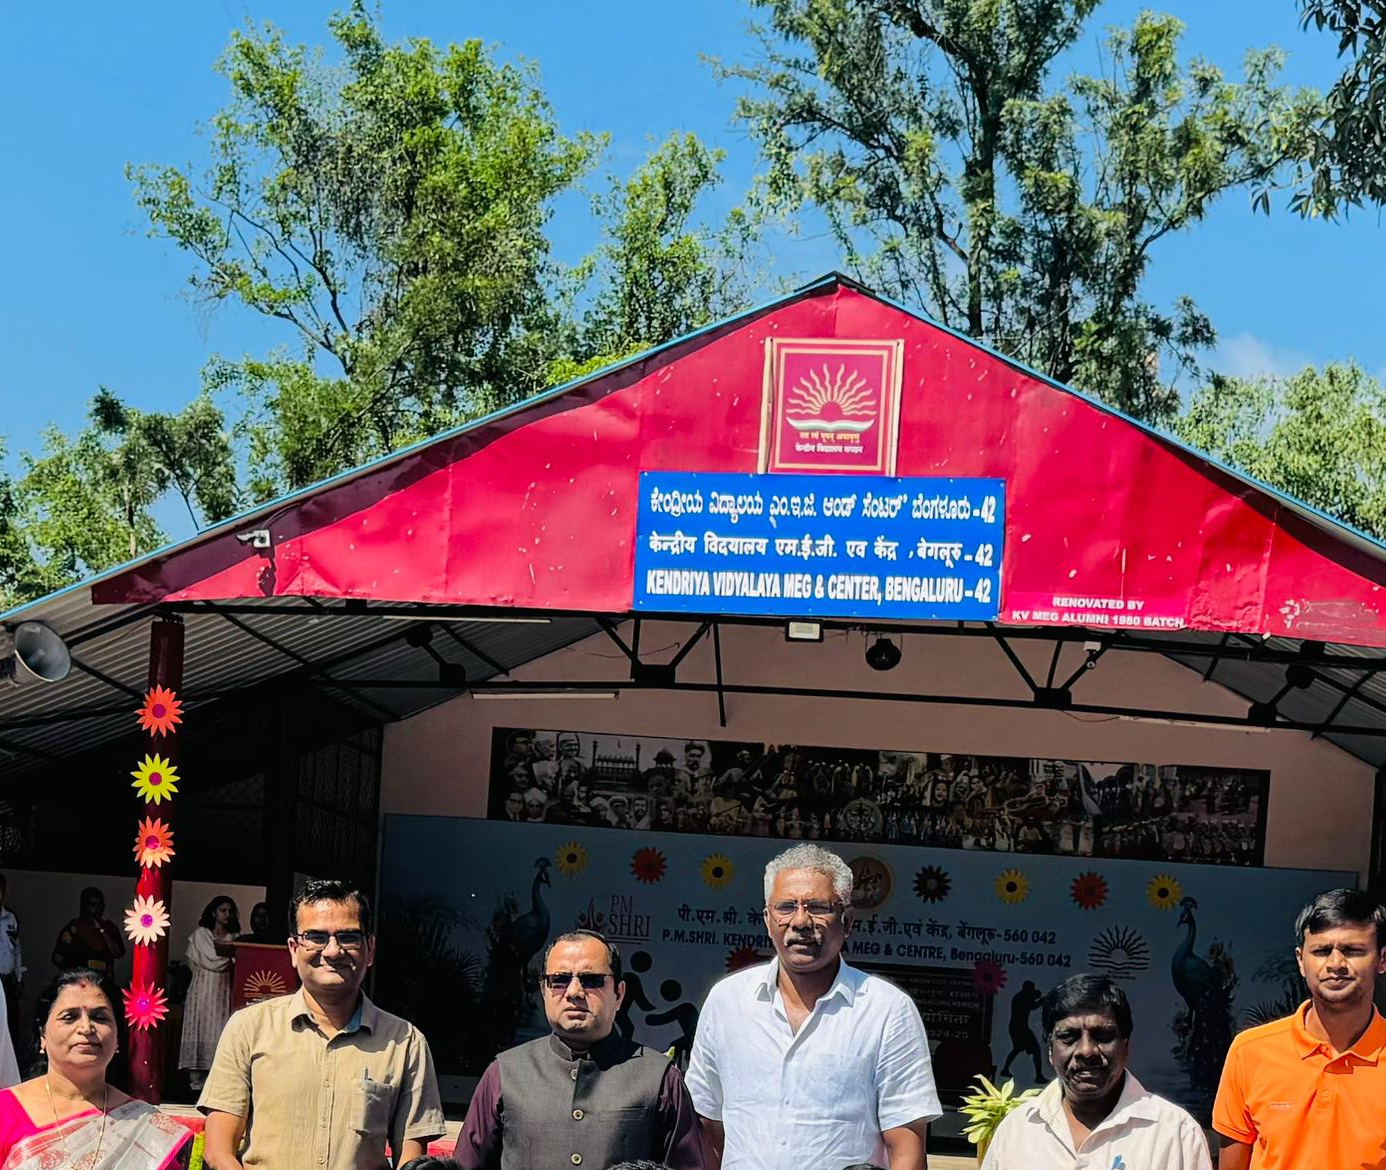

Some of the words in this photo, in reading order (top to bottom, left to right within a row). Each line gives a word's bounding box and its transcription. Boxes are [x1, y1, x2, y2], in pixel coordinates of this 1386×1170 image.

[646, 569, 711, 596] KENDRIYA
[712, 571, 781, 598] VIDYALAYA
[783, 573, 812, 599] MEG
[814, 574, 825, 600] &
[827, 574, 882, 606] CENTER,
[1052, 596, 1125, 610] RENOVATED
[1126, 600, 1145, 611] BY
[1012, 610, 1029, 621] KV
[1032, 610, 1059, 622] MEG
[1062, 612, 1109, 625] ALUMNI
[1112, 615, 1141, 626] 1980
[610, 894, 634, 914] PM
[608, 914, 652, 938] SHRI
[853, 940, 880, 956] MEG
[897, 943, 947, 962] CENTRE,
[1046, 953, 1072, 968] 042
